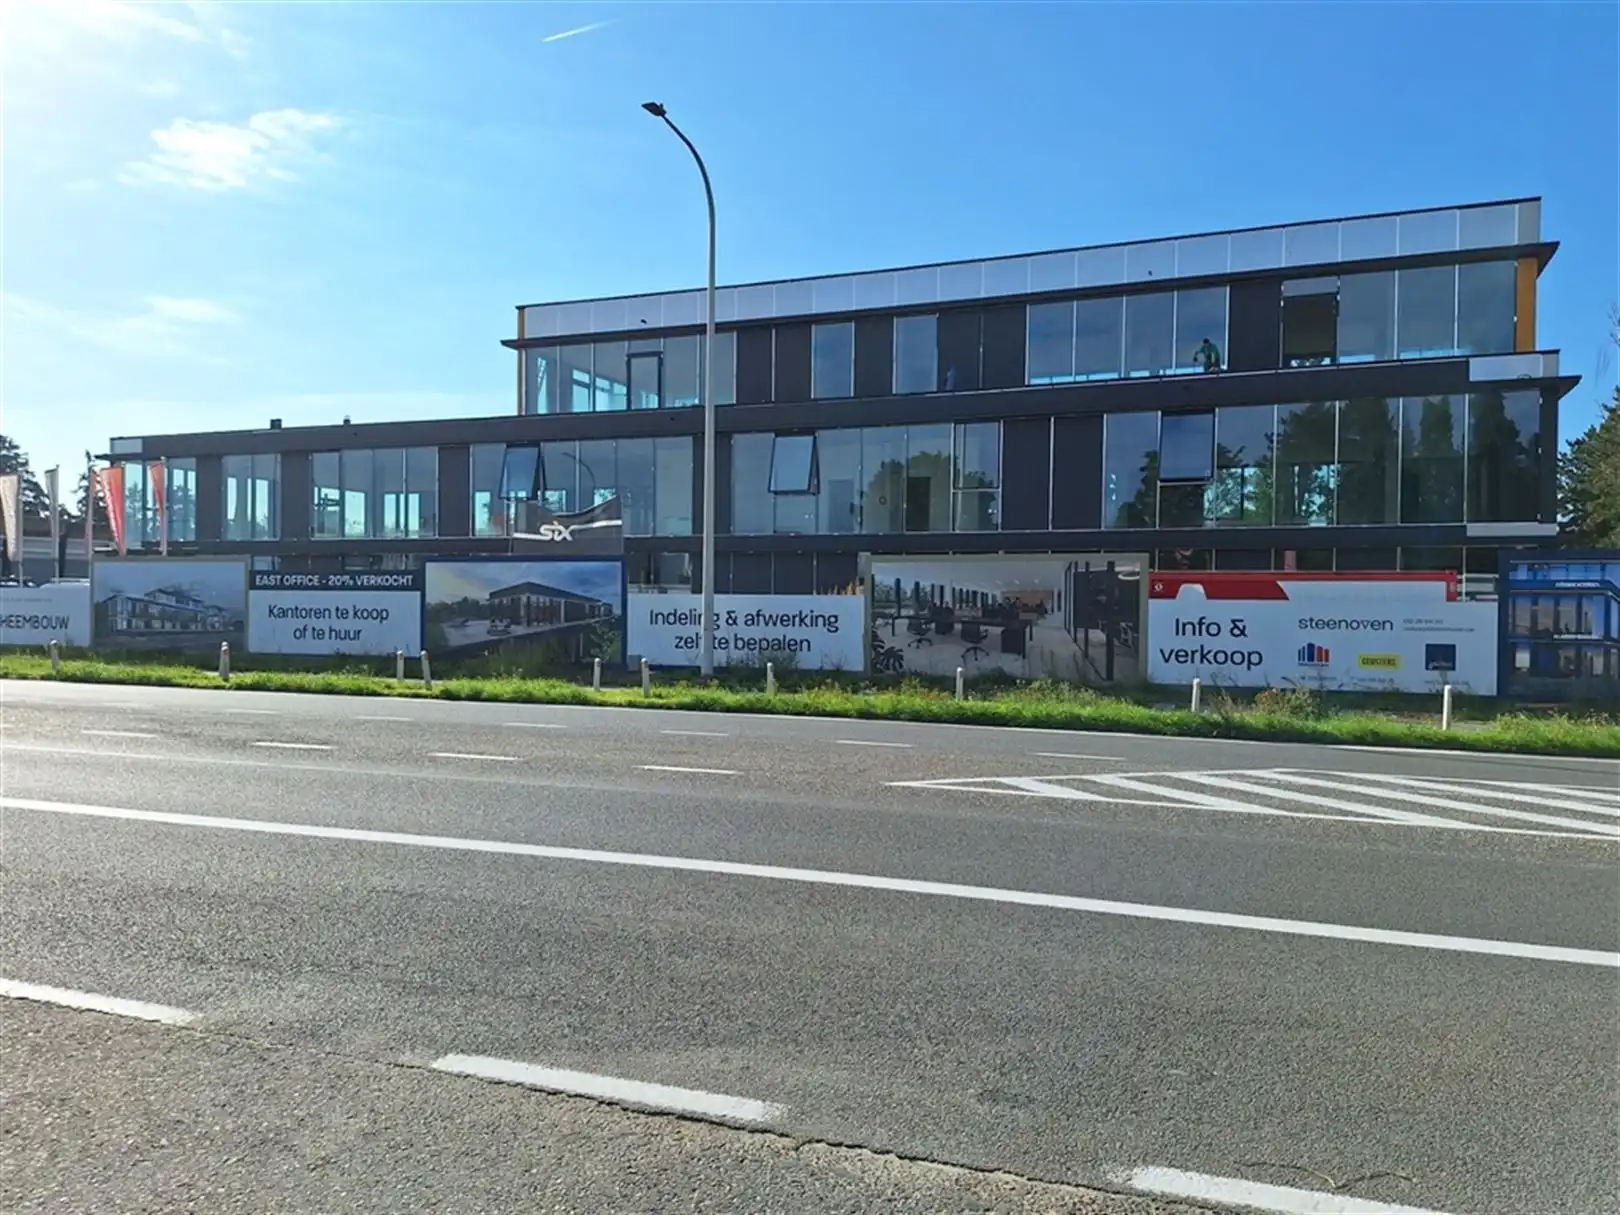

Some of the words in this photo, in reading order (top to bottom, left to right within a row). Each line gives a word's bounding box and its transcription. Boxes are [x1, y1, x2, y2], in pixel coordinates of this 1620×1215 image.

[255, 575, 281, 586] EAST
[283, 575, 320, 586] OFFICE
[328, 575, 354, 586] 20%
[355, 575, 414, 586] VERKOCHT
[268, 603, 331, 620] Kantoren
[335, 605, 349, 620] te
[353, 604, 390, 625] koop
[726, 610, 738, 626] &
[743, 608, 840, 633] afwerking
[1298, 616, 1394, 632] steenoven
[293, 624, 308, 640] of
[312, 626, 326, 640] te
[328, 625, 363, 641] huur
[1174, 616, 1221, 638] Info
[1229, 618, 1248, 638] &
[674, 632, 703, 649] zel
[712, 634, 729, 650] te
[734, 634, 812, 653] bepalen
[1160, 644, 1263, 671] verkoop
